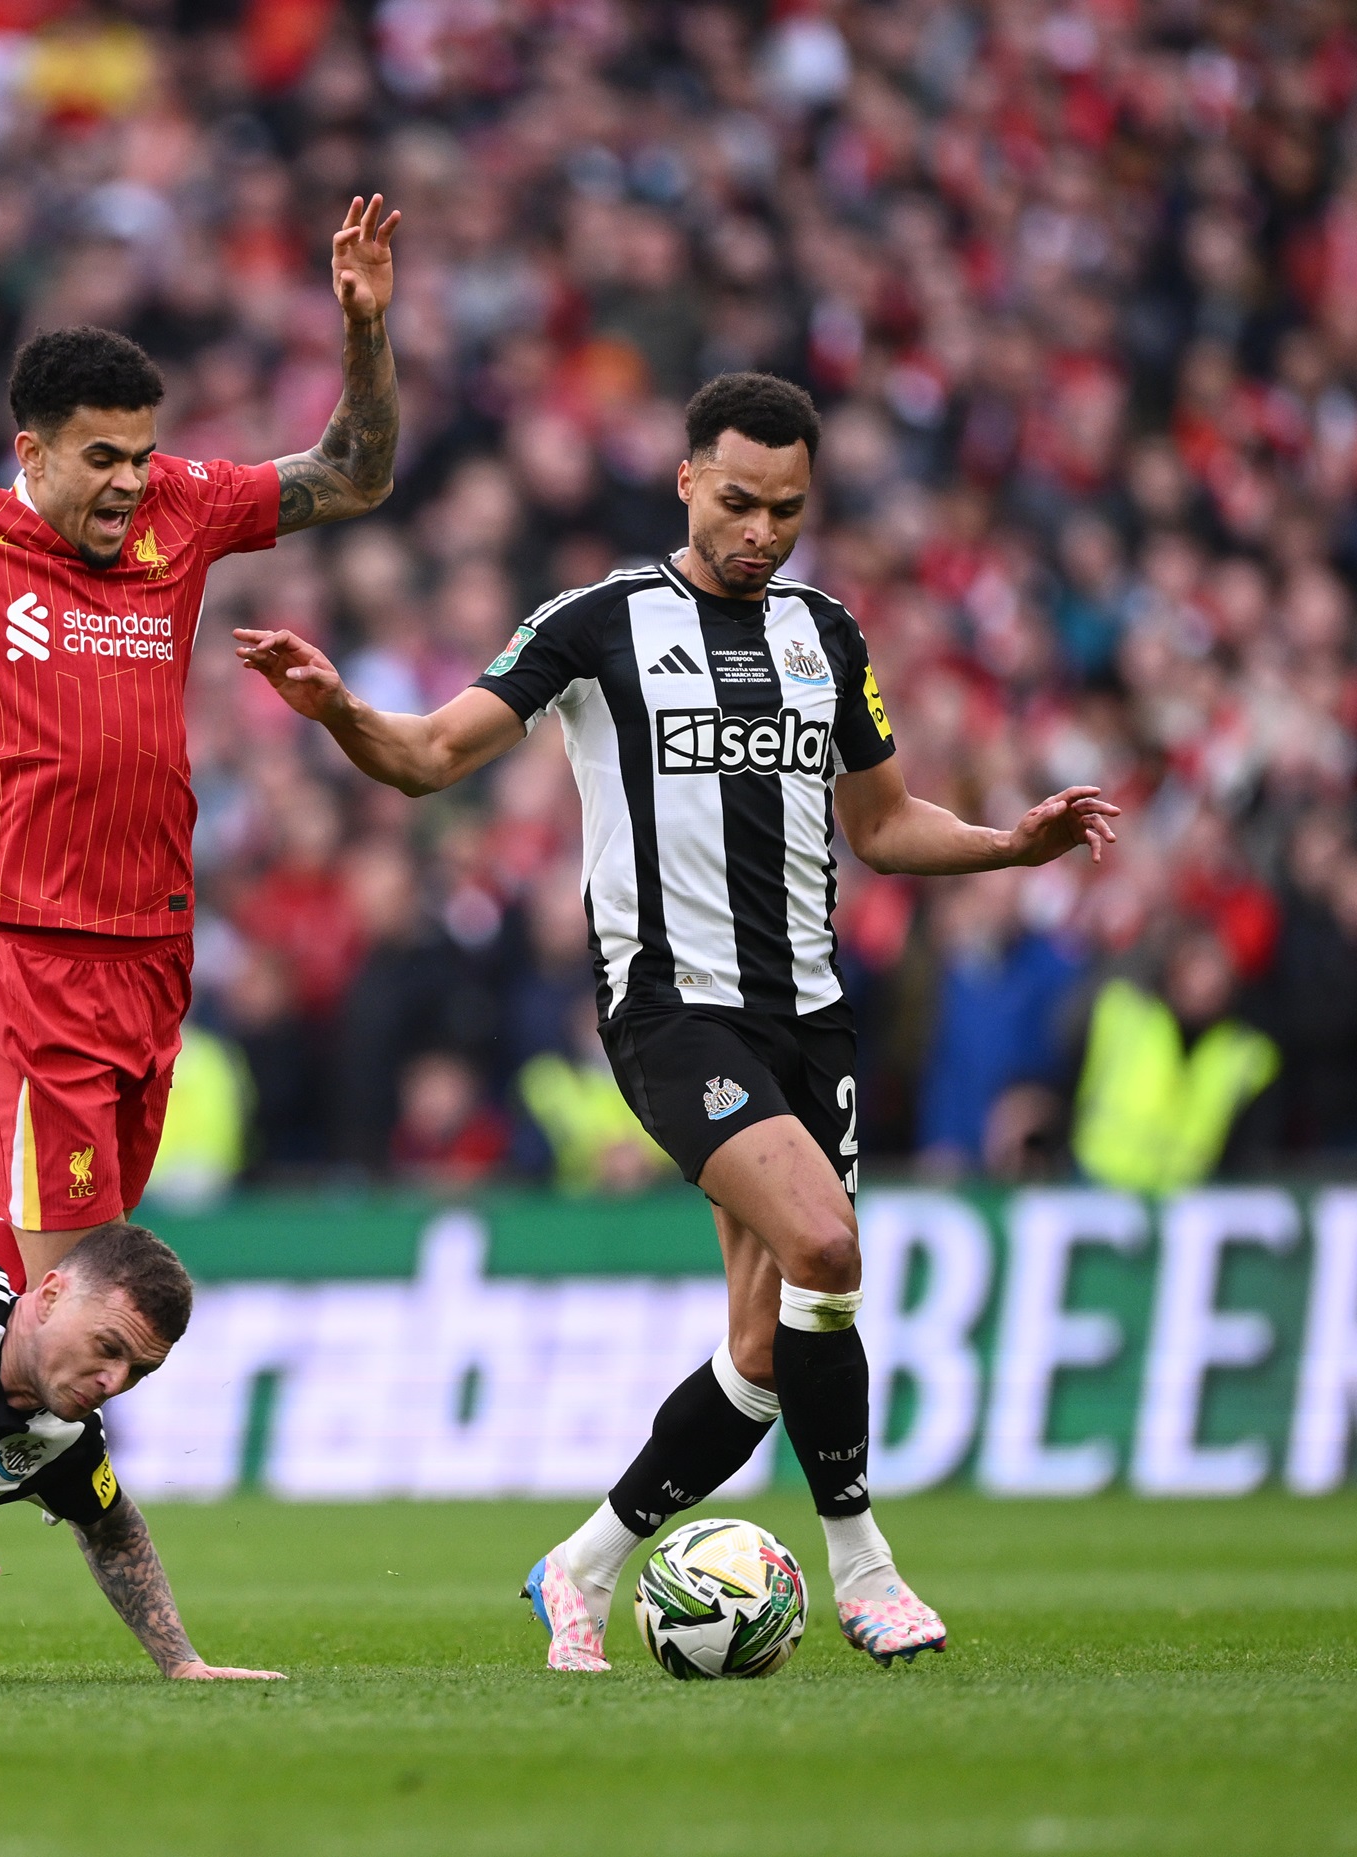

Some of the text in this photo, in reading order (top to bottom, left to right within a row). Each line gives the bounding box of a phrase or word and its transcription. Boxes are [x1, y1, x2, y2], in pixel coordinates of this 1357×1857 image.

[63, 608, 172, 637] standard
[63, 631, 174, 661] chartered
[719, 715, 826, 768] sela
[68, 1186, 97, 1199] L.F.C.
